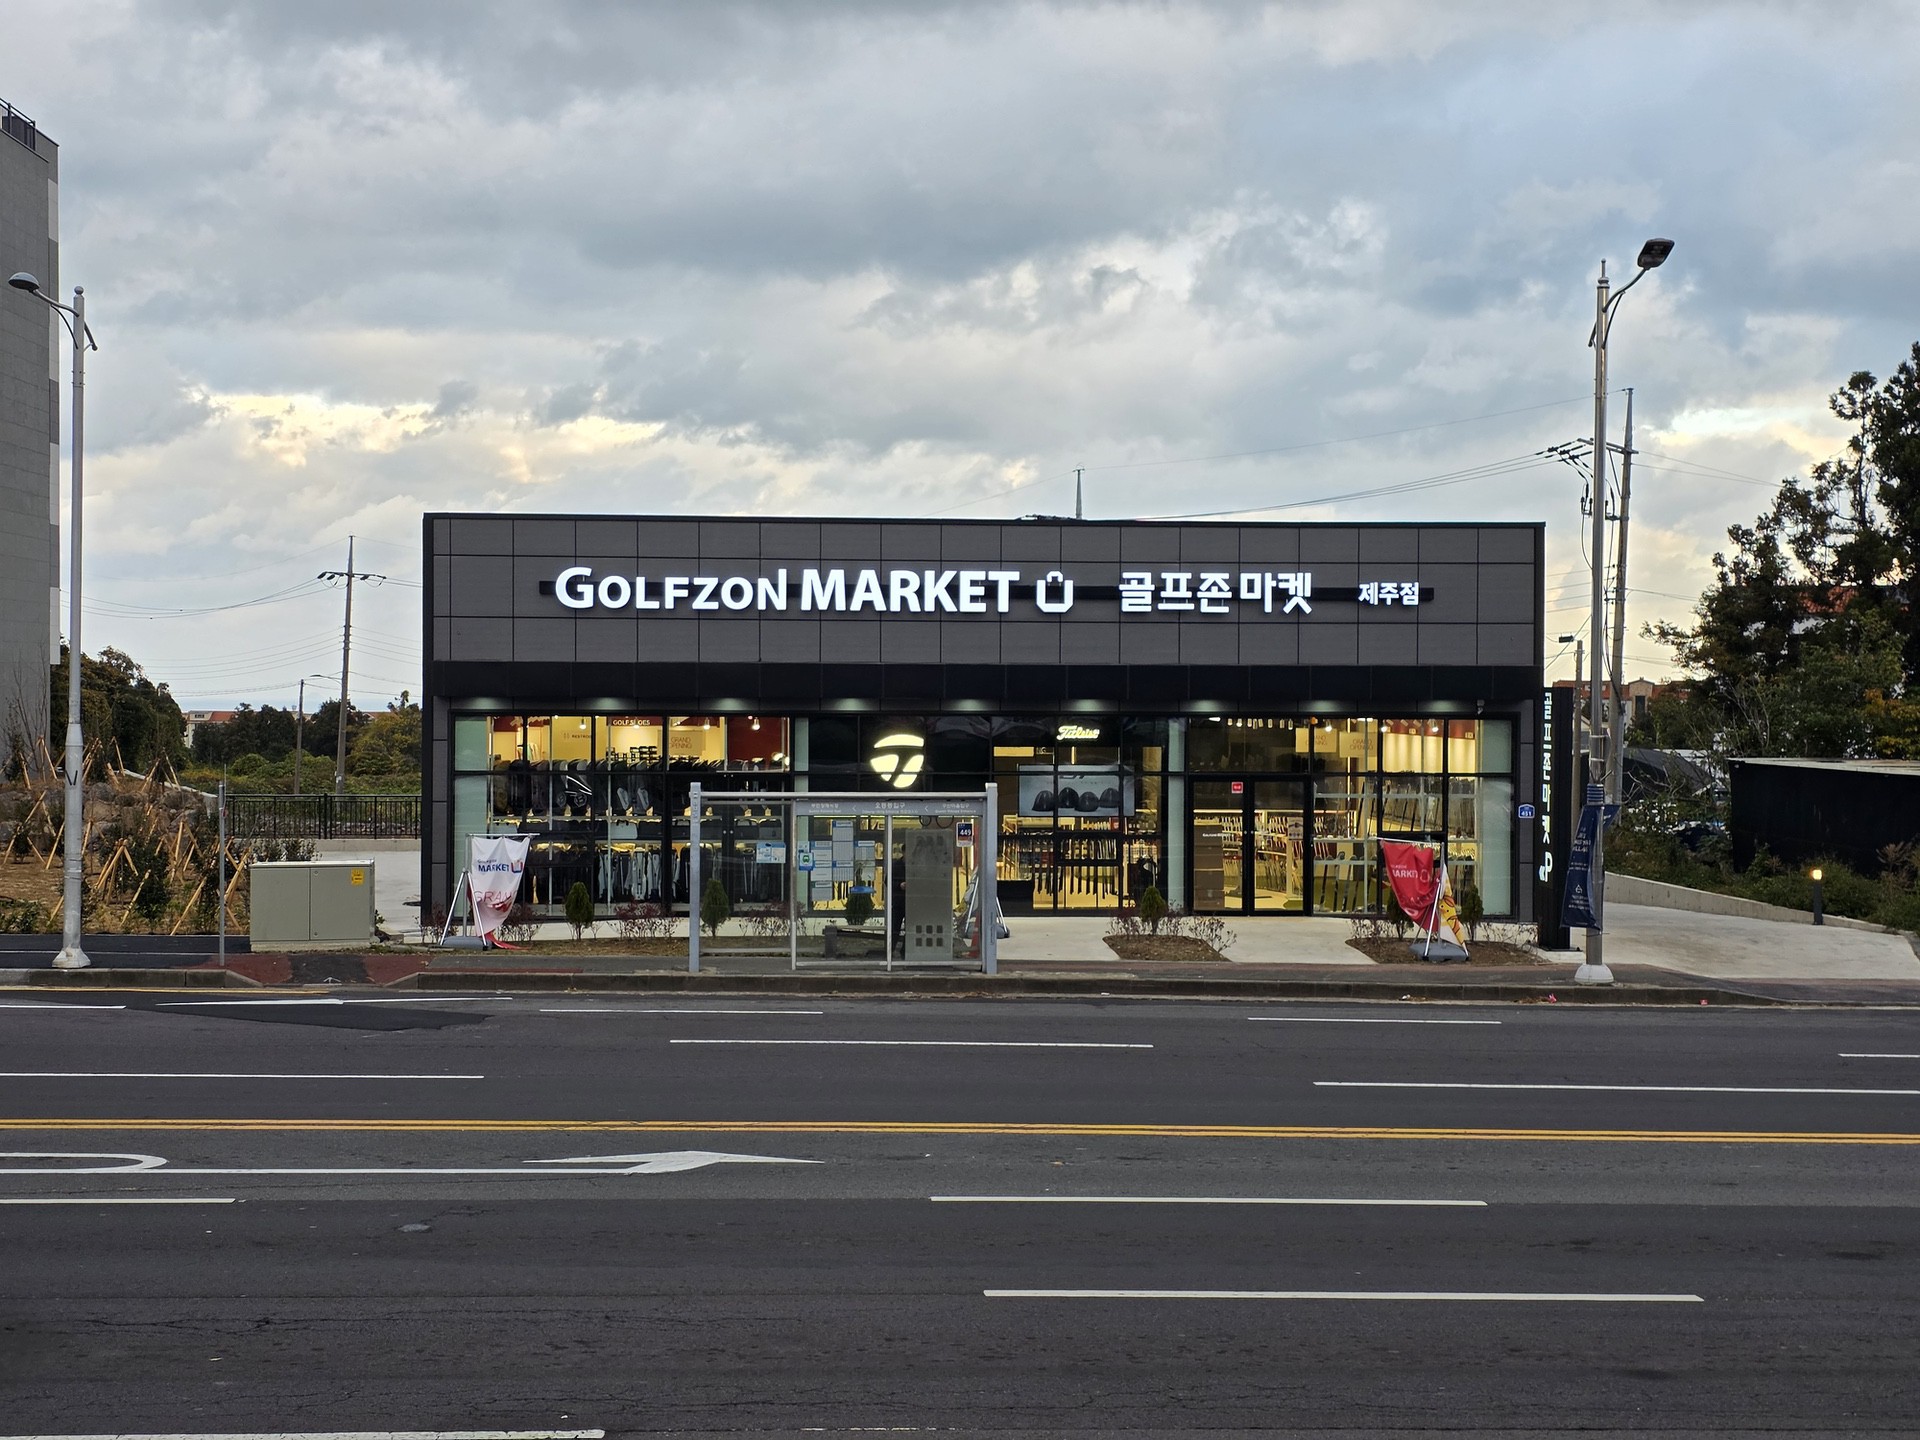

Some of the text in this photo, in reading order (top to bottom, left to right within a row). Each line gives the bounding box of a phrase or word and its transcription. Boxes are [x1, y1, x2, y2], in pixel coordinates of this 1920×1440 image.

[555, 566, 1020, 613] GOLFZON MARKET
[1358, 581, 1420, 606] 제주점
[959, 828, 972, 836] 449
[478, 863, 510, 873] MARKET
